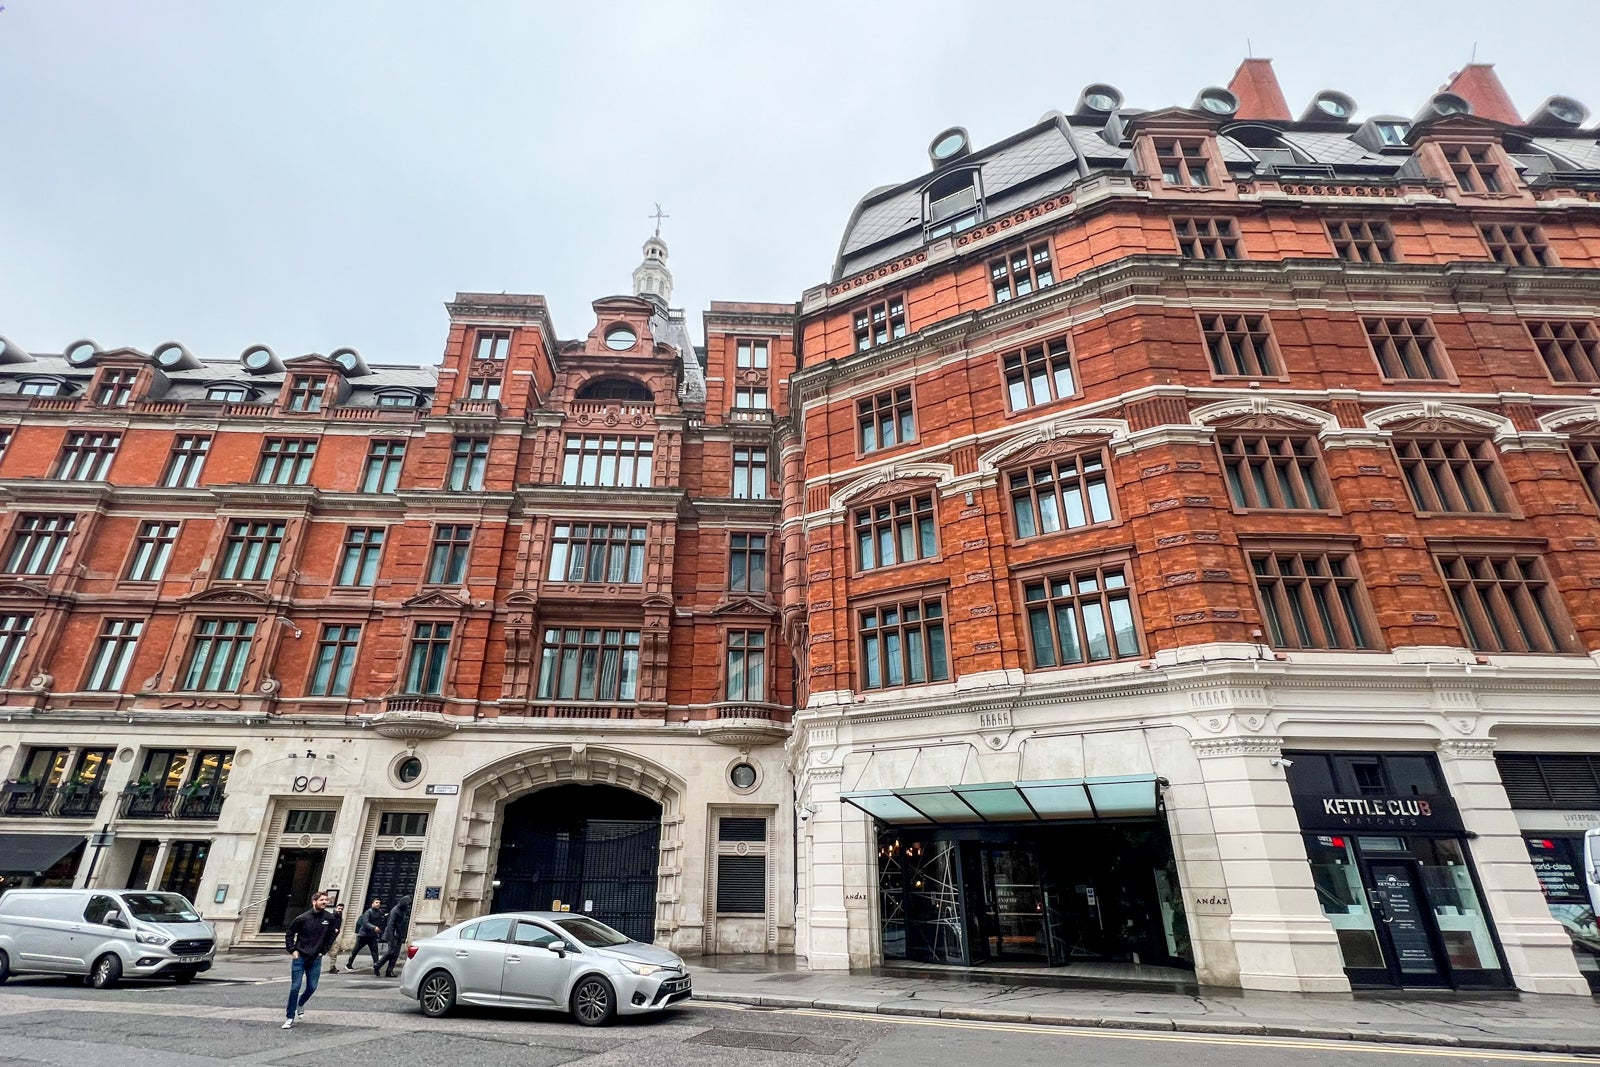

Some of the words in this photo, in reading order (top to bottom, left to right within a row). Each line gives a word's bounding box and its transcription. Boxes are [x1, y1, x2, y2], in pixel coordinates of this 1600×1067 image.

[292, 776, 327, 793] 1901
[1323, 799, 1386, 815] KETTLE
[1387, 800, 1431, 816] CLUB
[1343, 818, 1417, 826] WATCHES
